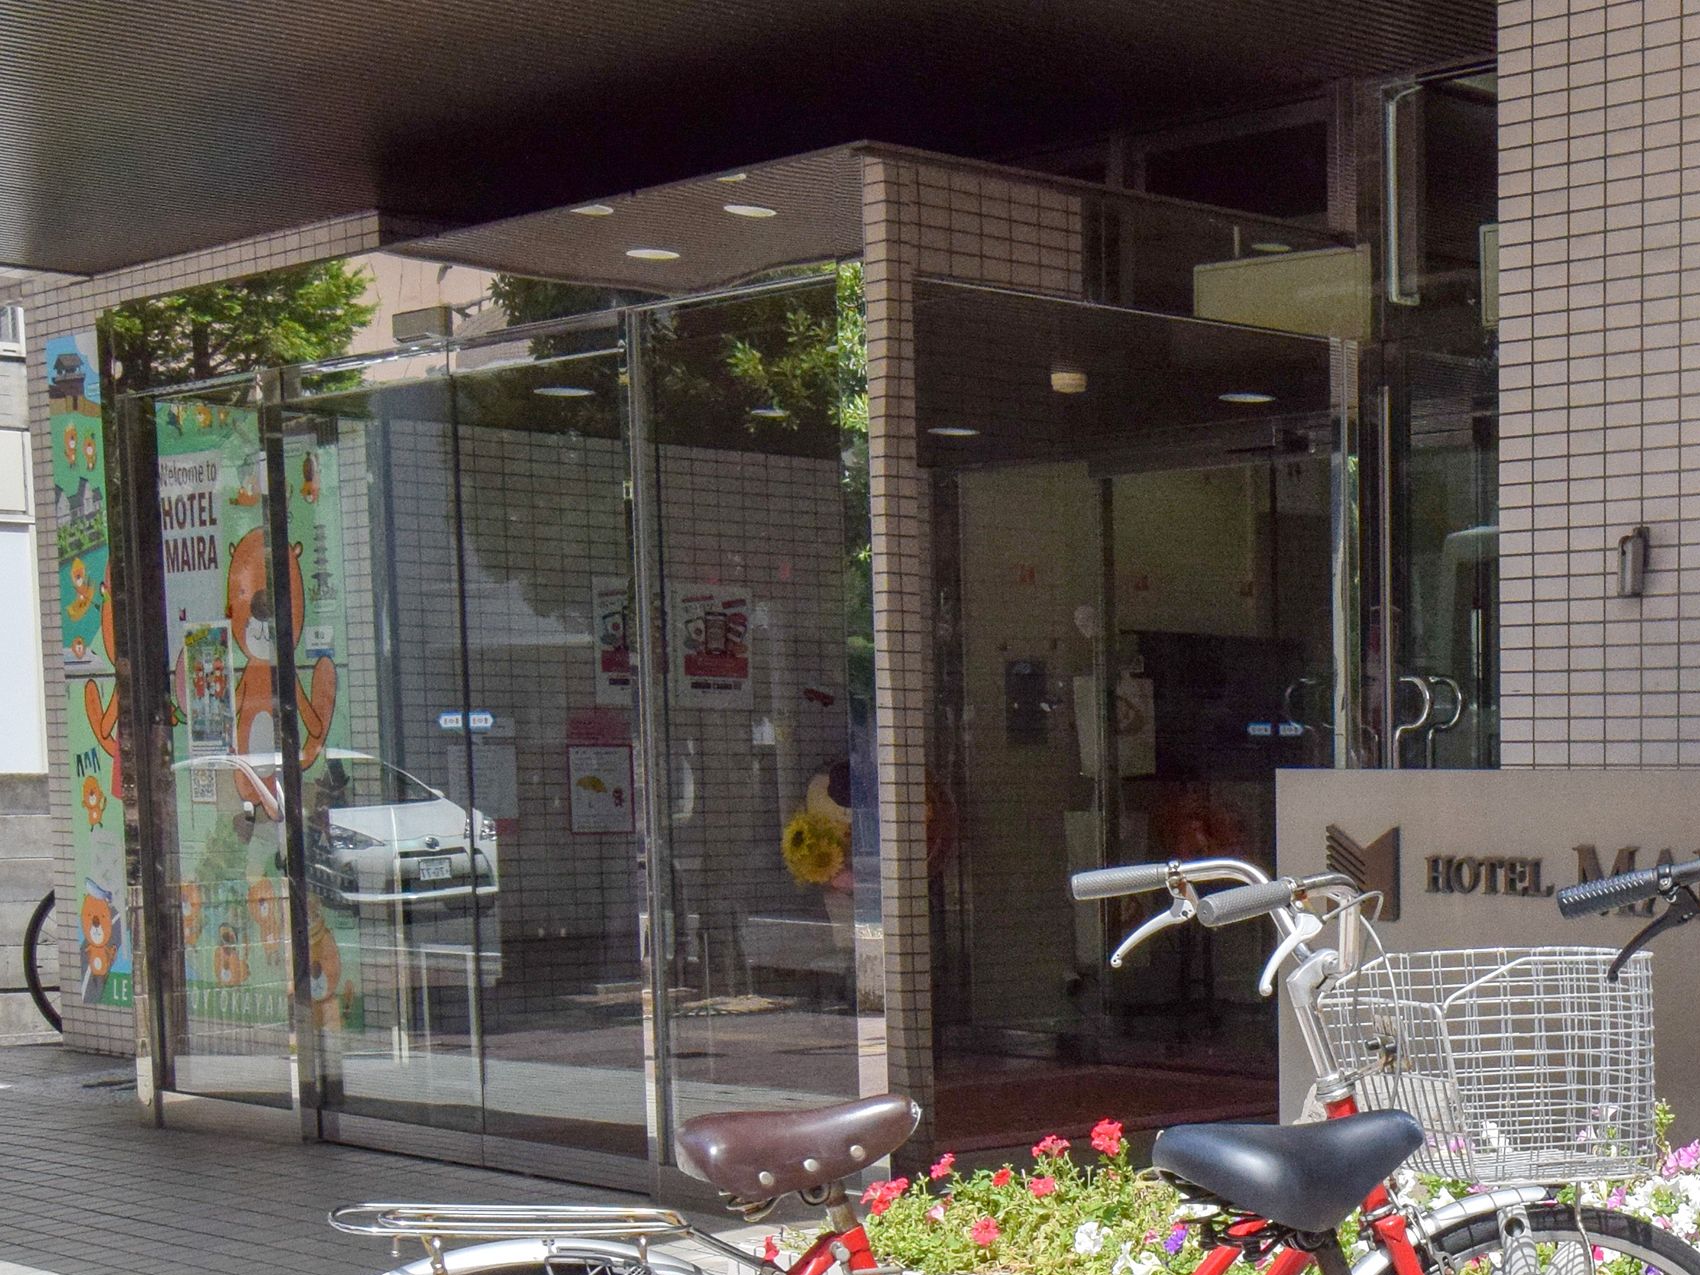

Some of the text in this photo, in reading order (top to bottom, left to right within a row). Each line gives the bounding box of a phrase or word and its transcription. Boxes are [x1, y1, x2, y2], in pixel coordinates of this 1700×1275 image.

[161, 459, 218, 488] Welcome to
[161, 491, 218, 531] HOTEL
[164, 534, 219, 574] MAIRA
[1424, 853, 1555, 898] HOTEL
